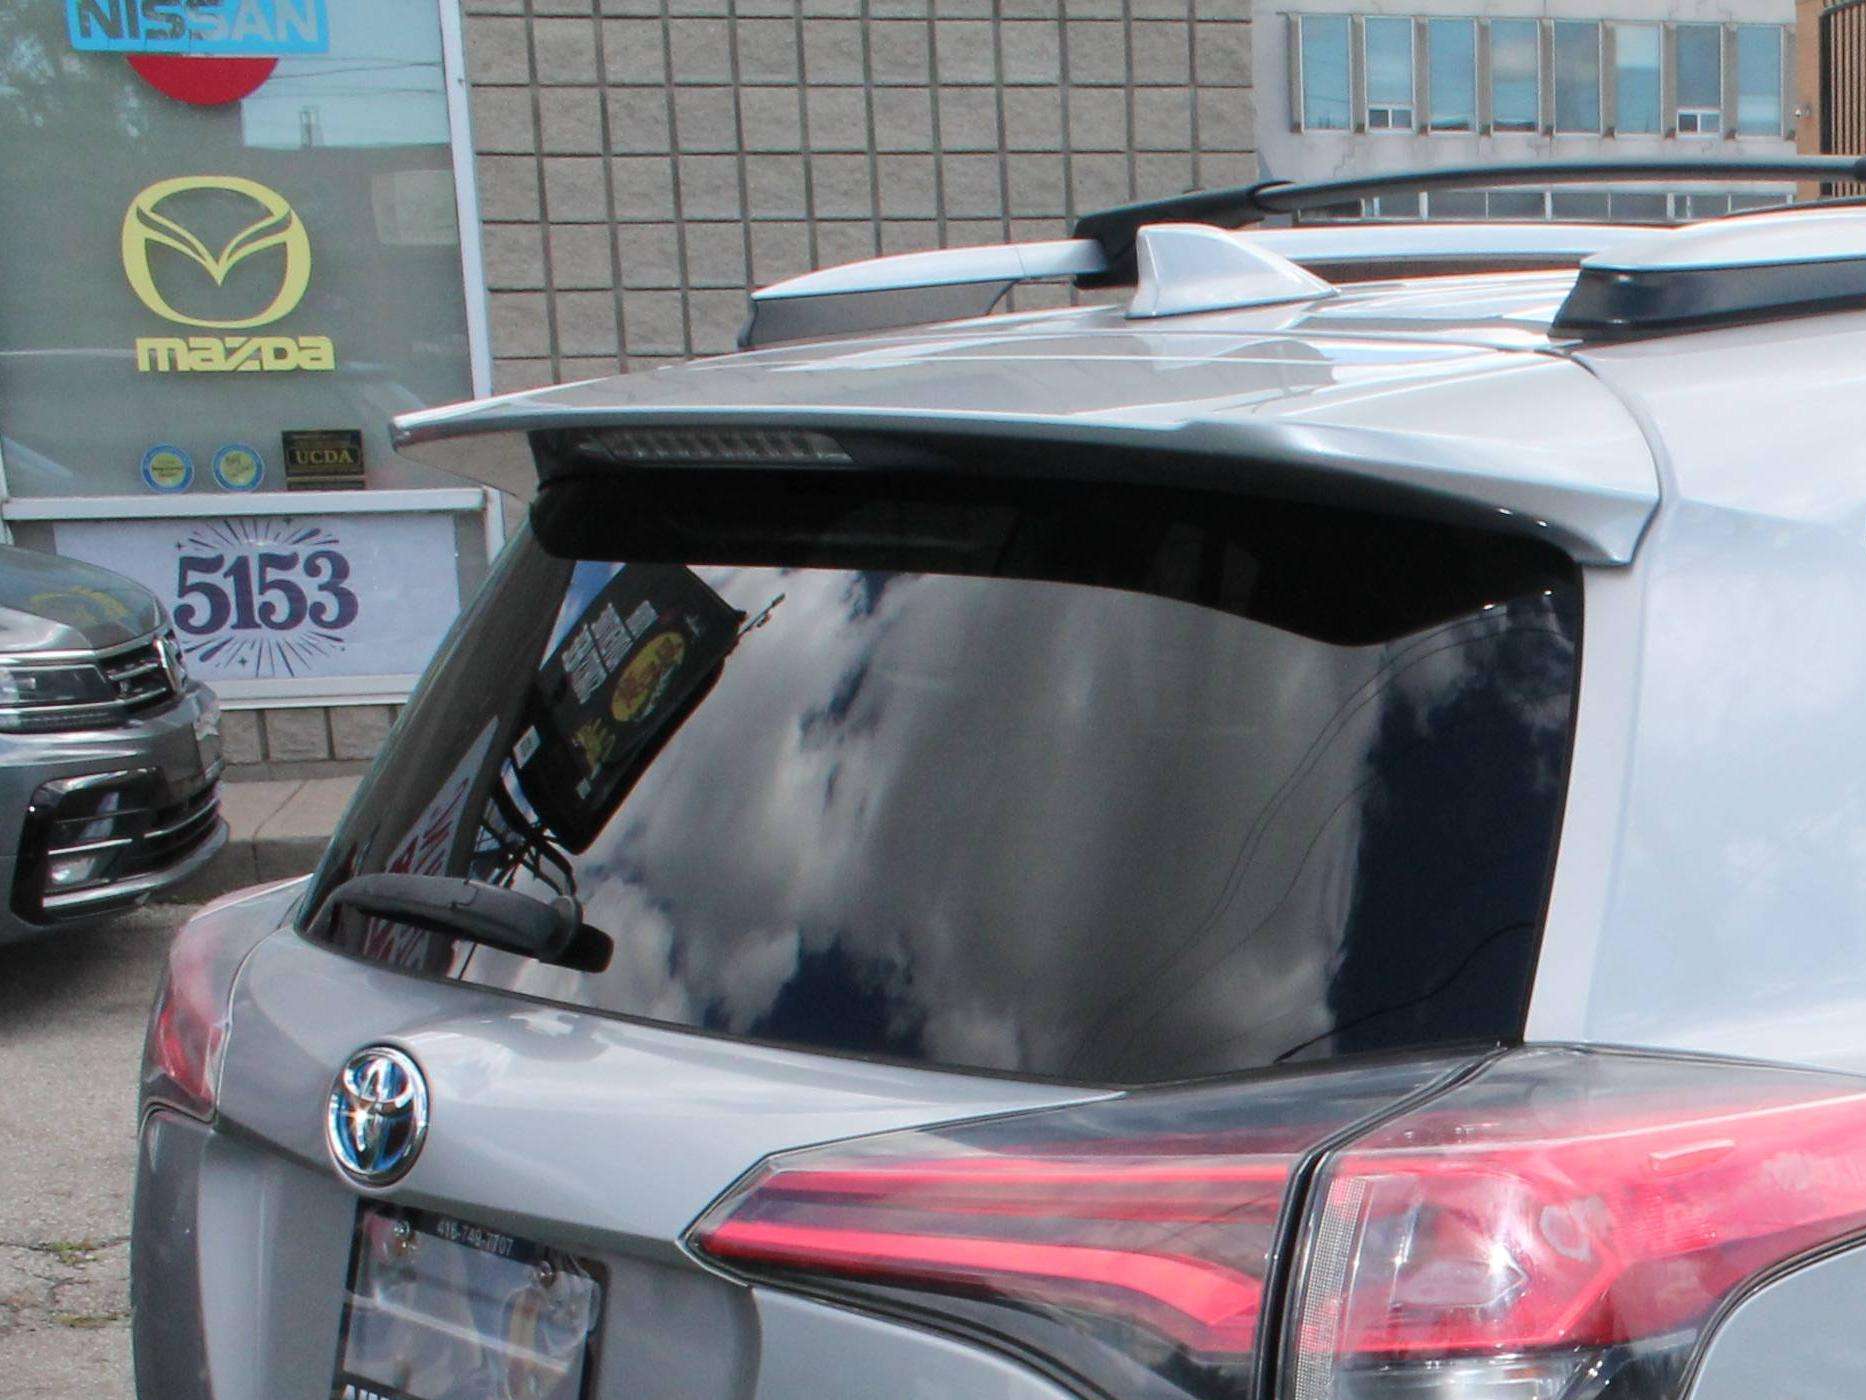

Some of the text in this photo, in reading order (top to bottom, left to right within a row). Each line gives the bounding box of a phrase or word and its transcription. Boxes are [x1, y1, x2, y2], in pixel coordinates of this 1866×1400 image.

[76, 0, 318, 40] NISSAN
[295, 448, 354, 465] UCDA
[174, 550, 359, 635] 5153
